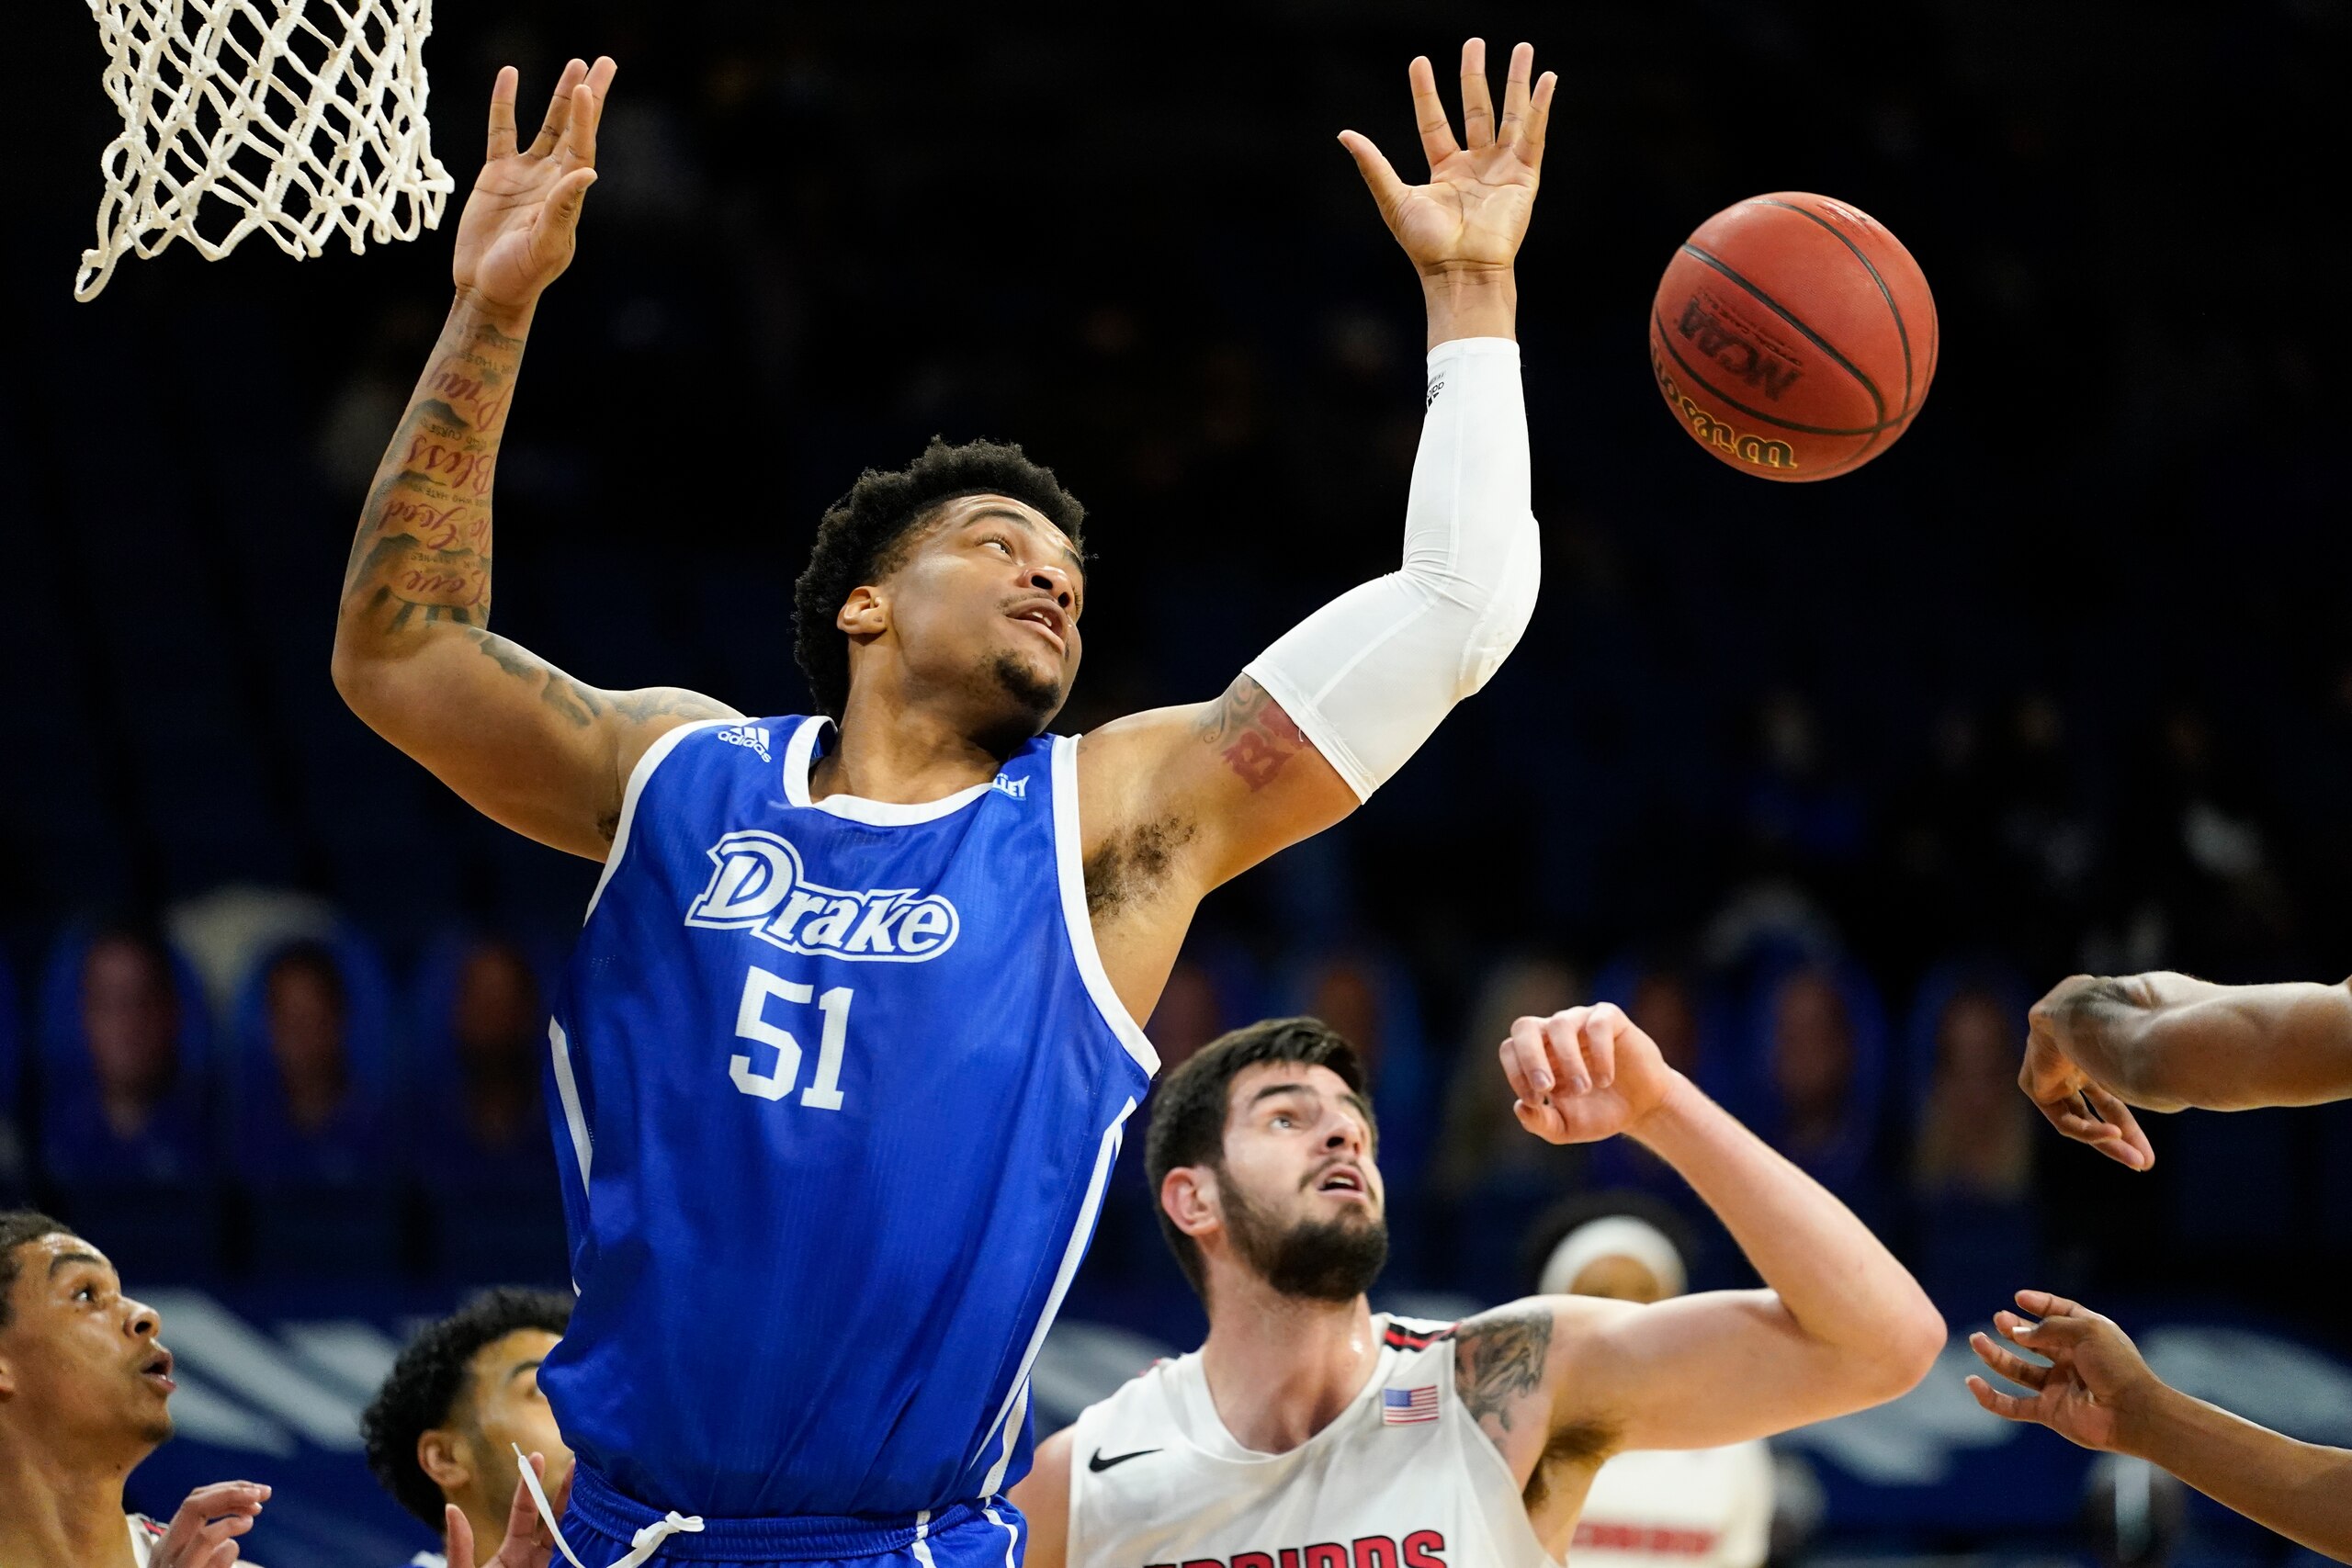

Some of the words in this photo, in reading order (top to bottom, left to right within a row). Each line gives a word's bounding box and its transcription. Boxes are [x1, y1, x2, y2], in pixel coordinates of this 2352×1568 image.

[1678, 295, 1801, 402] NCAA
[425, 355, 514, 433] Pray
[405, 434, 495, 498] Bless
[375, 500, 469, 551] Good
[718, 729, 772, 763] adidas
[684, 829, 960, 964] Drake
[729, 964, 854, 1111] 51
